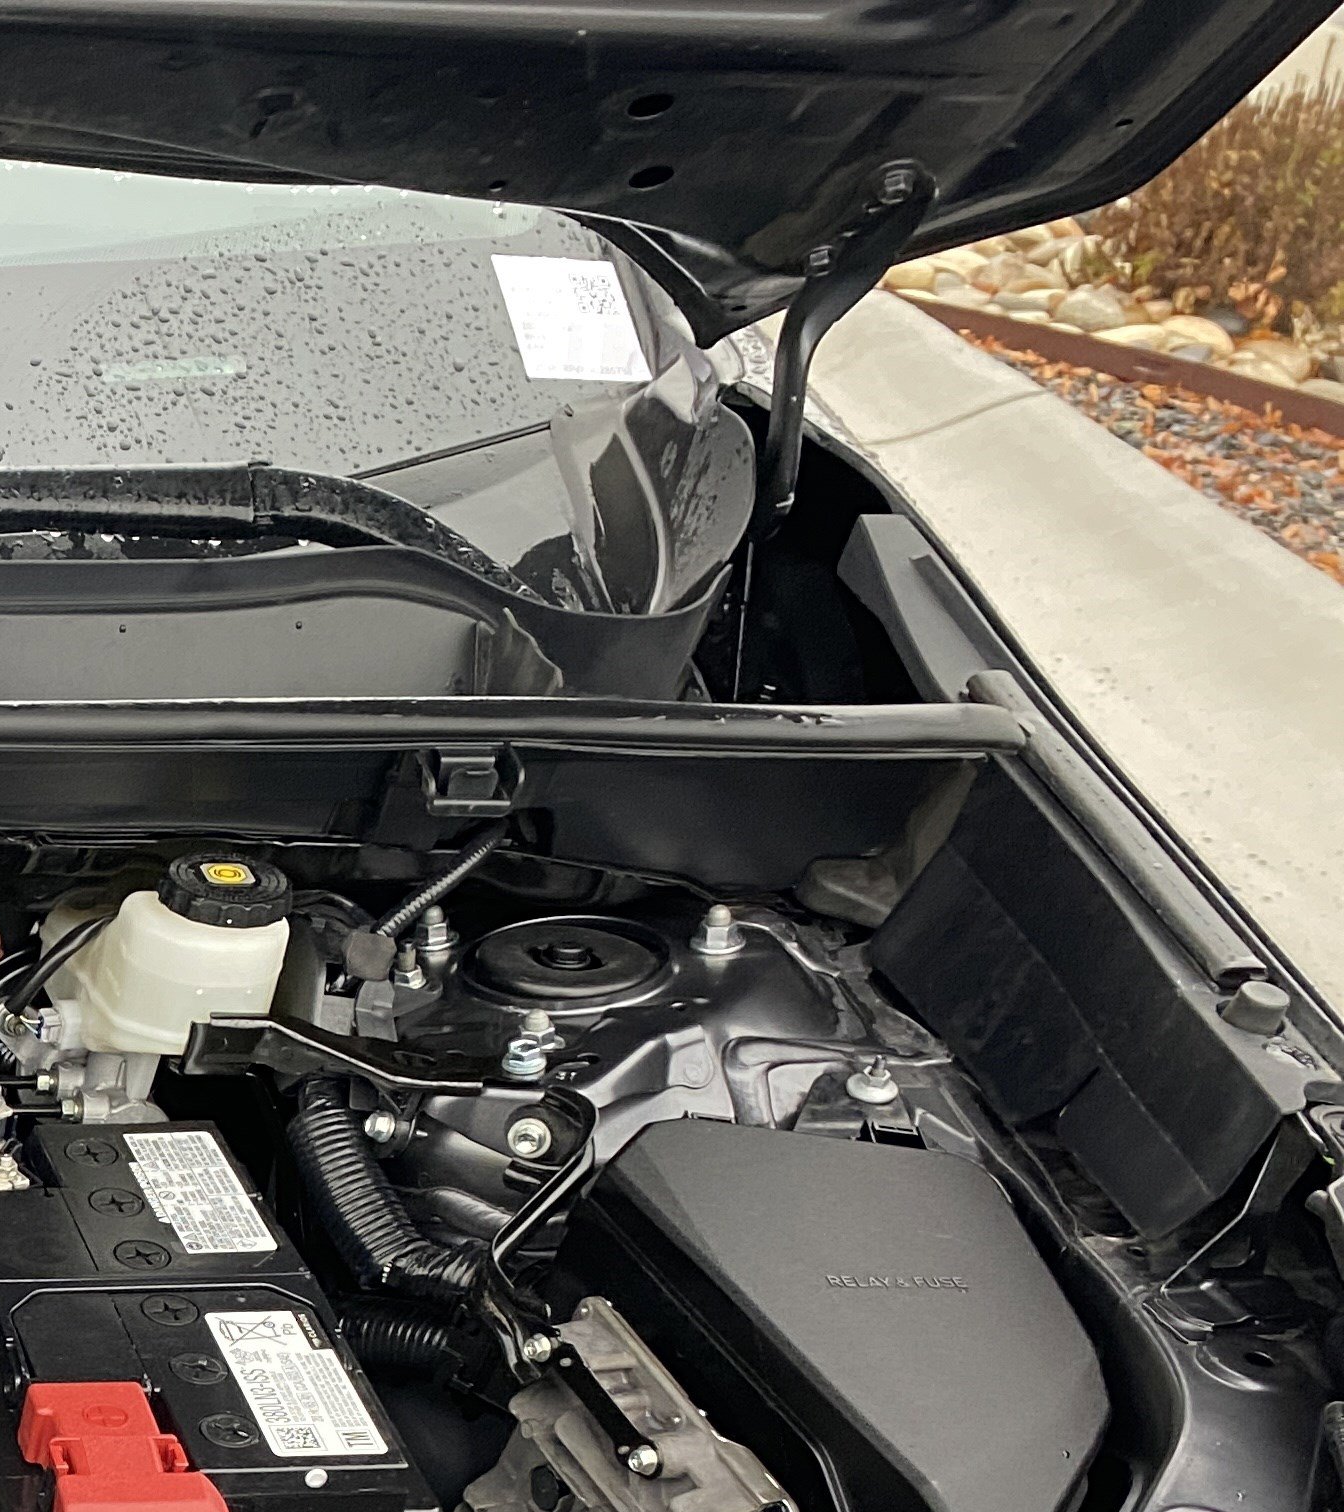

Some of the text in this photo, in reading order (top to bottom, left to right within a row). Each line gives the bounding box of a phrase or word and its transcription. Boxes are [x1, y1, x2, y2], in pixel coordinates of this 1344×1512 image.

[826, 1274, 969, 1291] RELAY & FUSE
[342, 1430, 374, 1449] TM
